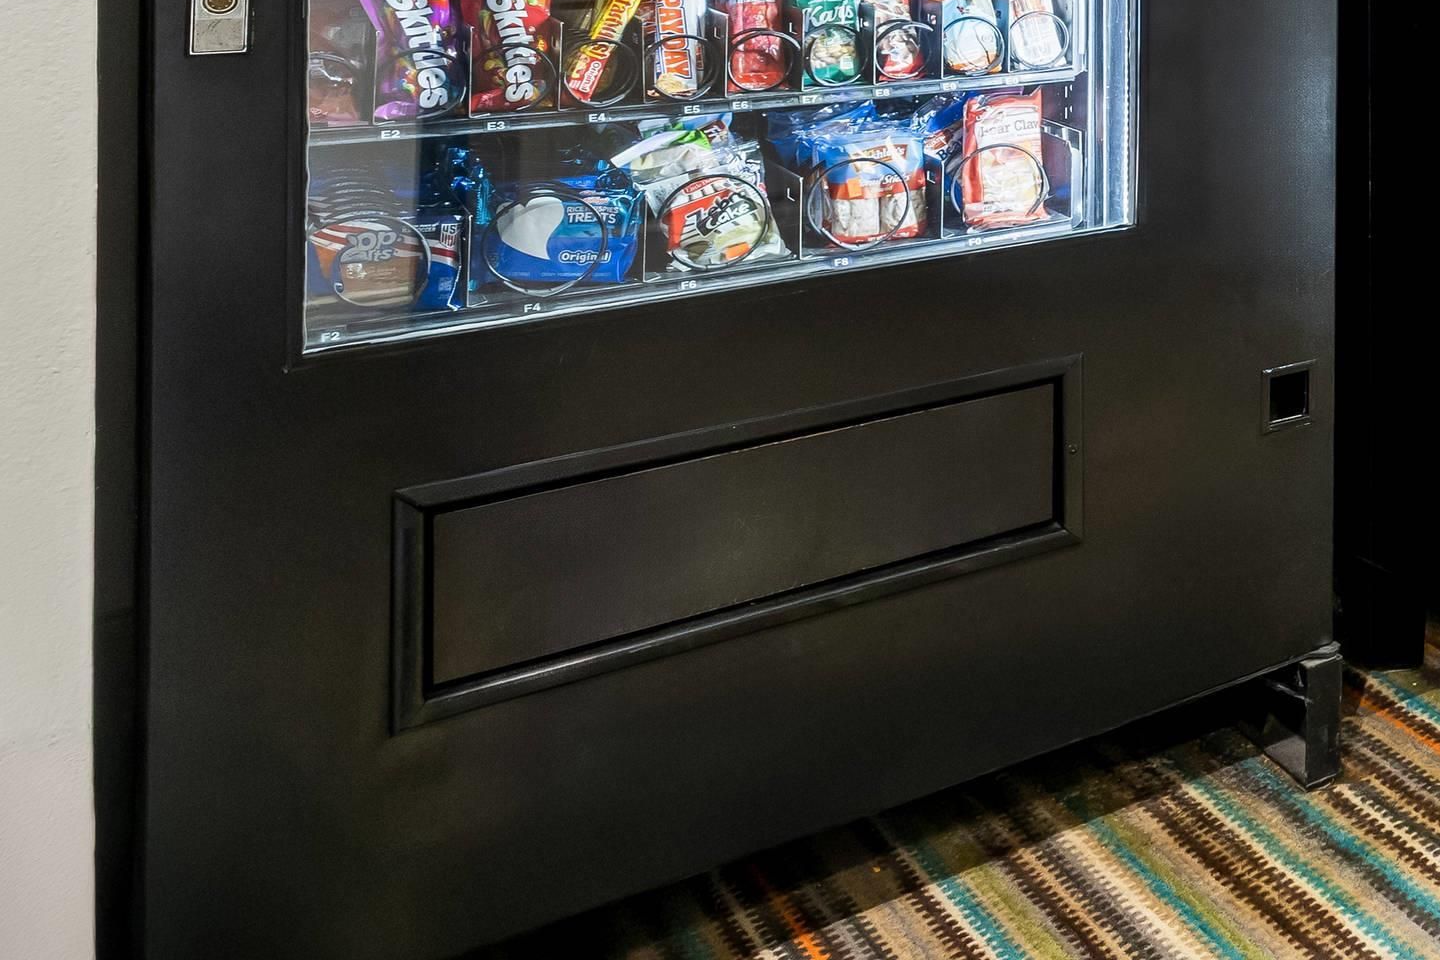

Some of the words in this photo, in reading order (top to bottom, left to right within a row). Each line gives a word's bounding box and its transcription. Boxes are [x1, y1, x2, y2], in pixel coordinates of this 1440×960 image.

[802, 95, 819, 103] E7
[684, 104, 701, 114] E5
[732, 101, 749, 110] E6
[588, 113, 607, 122] E4
[486, 121, 506, 130] E3
[380, 130, 401, 139] E2
[560, 251, 610, 264] Originl
[834, 258, 849, 267] F8
[681, 280, 697, 290] F6
[523, 302, 542, 313] F4
[320, 332, 341, 342] F2
